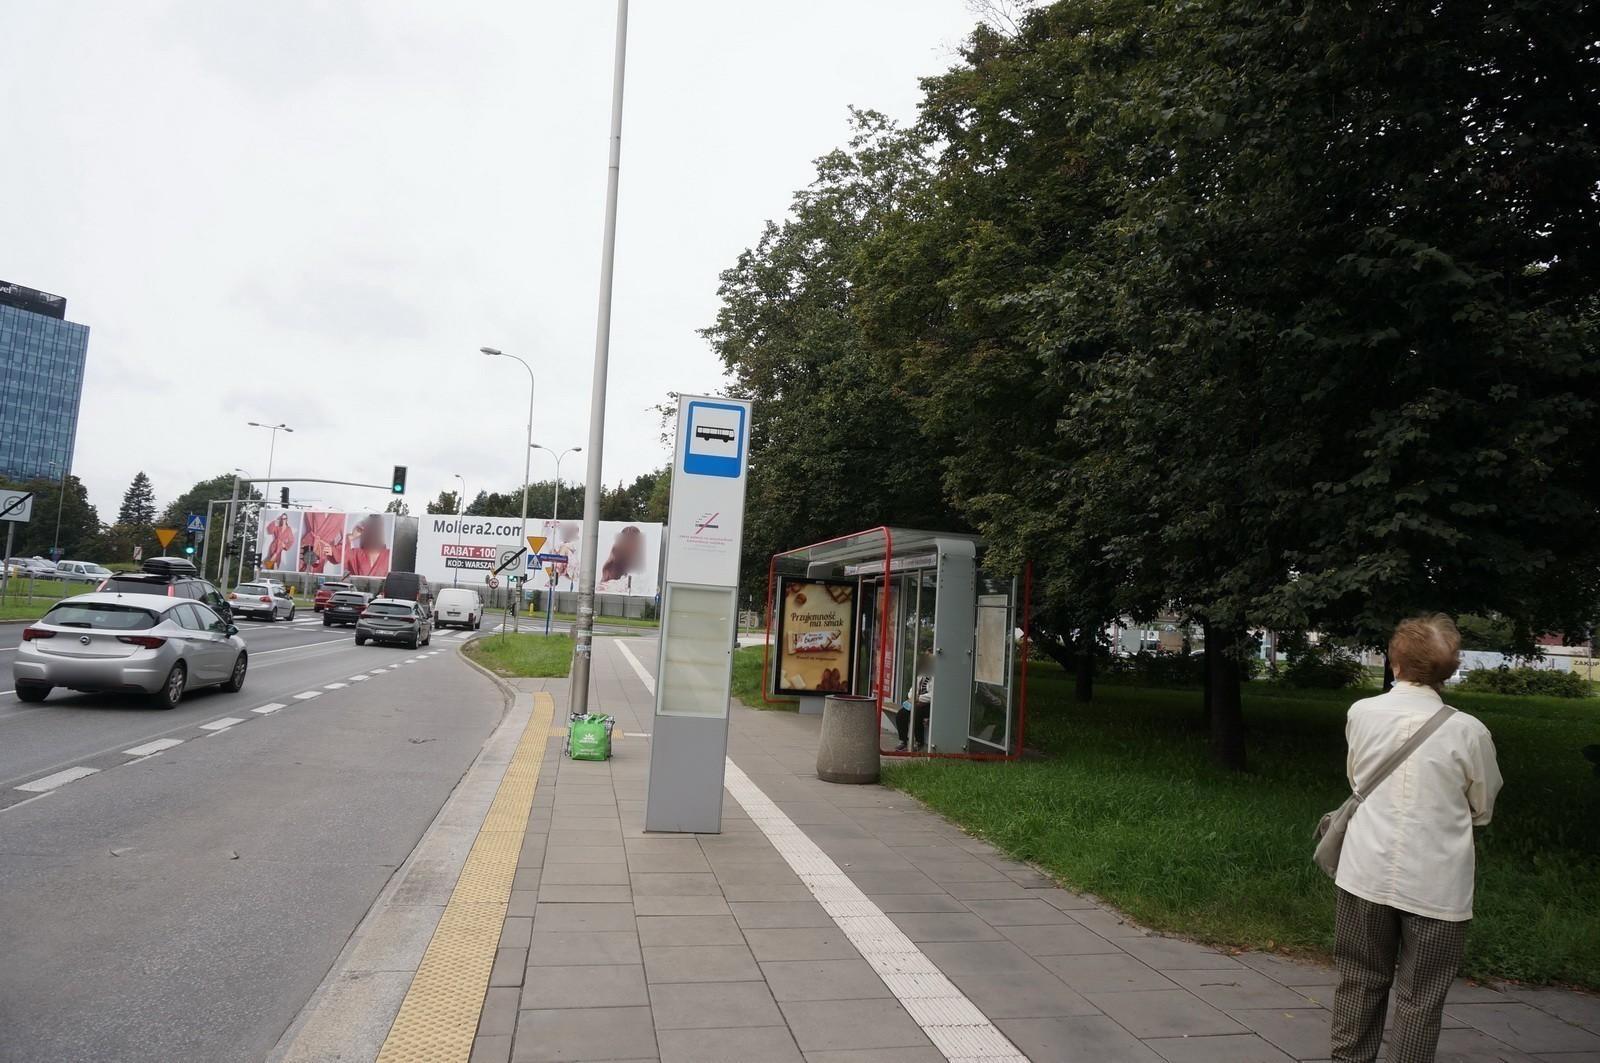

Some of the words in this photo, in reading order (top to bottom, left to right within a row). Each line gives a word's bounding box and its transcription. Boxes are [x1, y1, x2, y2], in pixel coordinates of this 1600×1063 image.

[433, 520, 523, 536] Moliera2.com
[443, 546, 474, 557] RABAT
[476, 548, 496, 558] -100
[447, 559, 464, 567] KOD:
